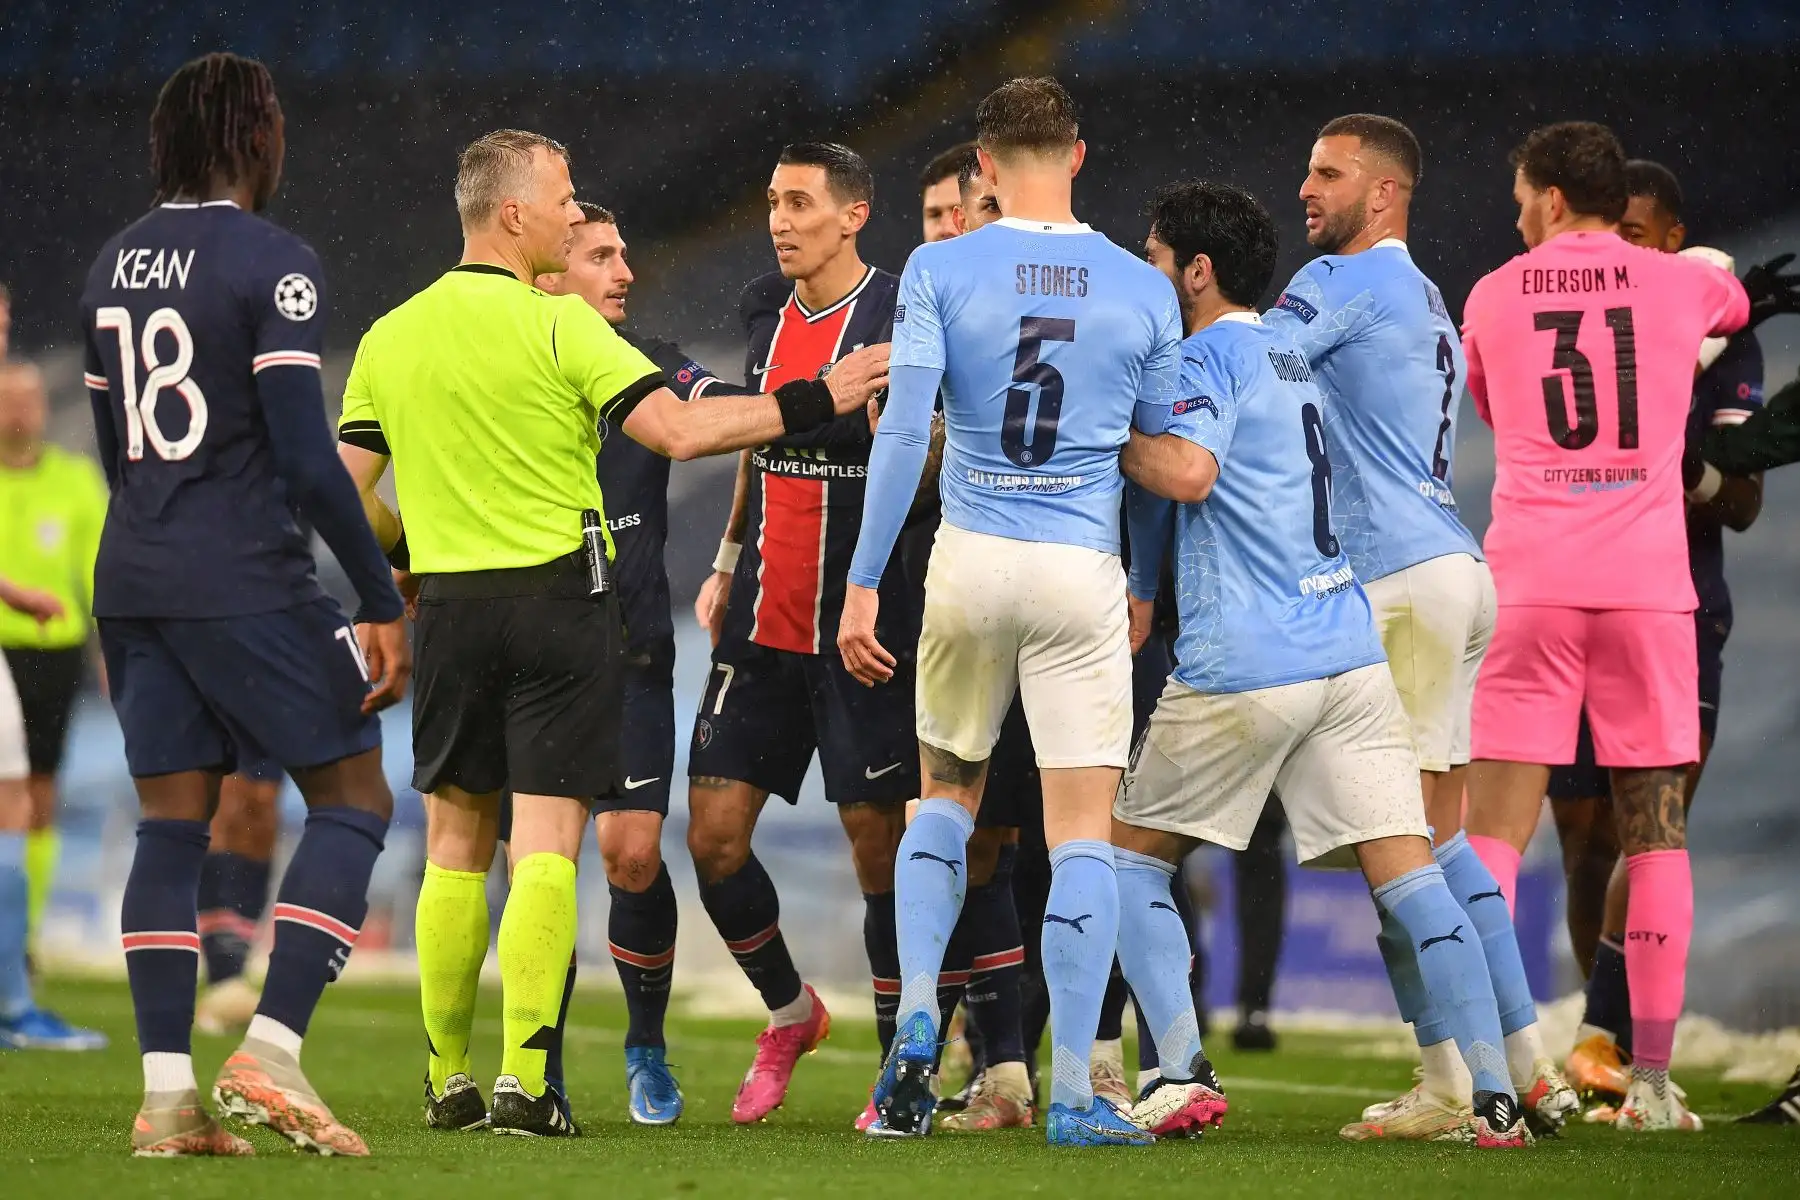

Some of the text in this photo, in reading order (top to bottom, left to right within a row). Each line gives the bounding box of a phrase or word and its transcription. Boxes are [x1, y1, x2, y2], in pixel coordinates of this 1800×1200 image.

[111, 248, 196, 289] KEAN
[1015, 263, 1089, 298] STONES
[1522, 265, 1638, 295] EDERSON M.
[1284, 298, 1315, 320] RESPECT
[96, 306, 209, 462] 18
[1000, 315, 1076, 468] 5
[1533, 306, 1639, 450] 31
[770, 459, 800, 474] LIVE
[1302, 402, 1341, 558] 8
[1544, 467, 1647, 483] CITYZENS GIVING
[1627, 930, 1668, 945] CITY
